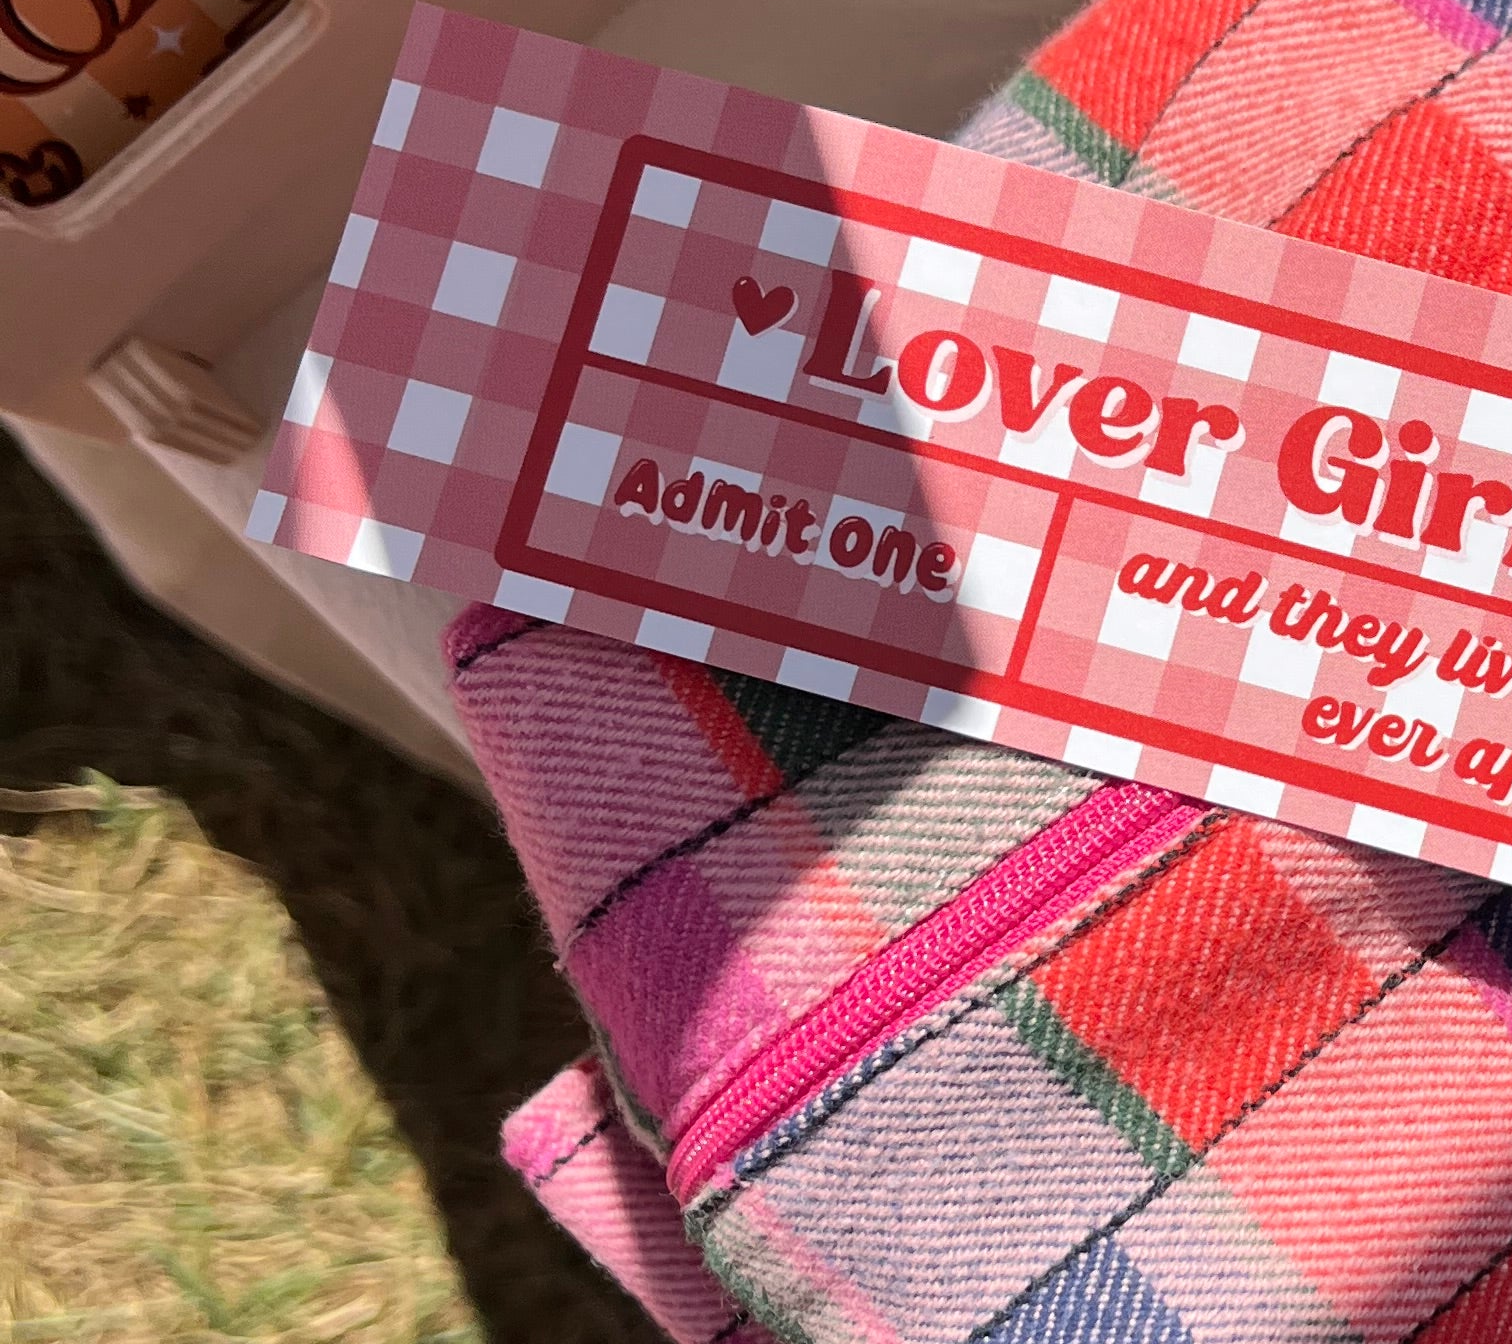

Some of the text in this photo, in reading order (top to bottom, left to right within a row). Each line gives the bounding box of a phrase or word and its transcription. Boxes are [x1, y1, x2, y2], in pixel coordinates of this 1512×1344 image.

[802, 267, 1241, 476] Lover
[613, 458, 957, 591] Admit one
[1117, 553, 1260, 625] and
[1268, 582, 1431, 687] they
[1301, 690, 1443, 771] ever
